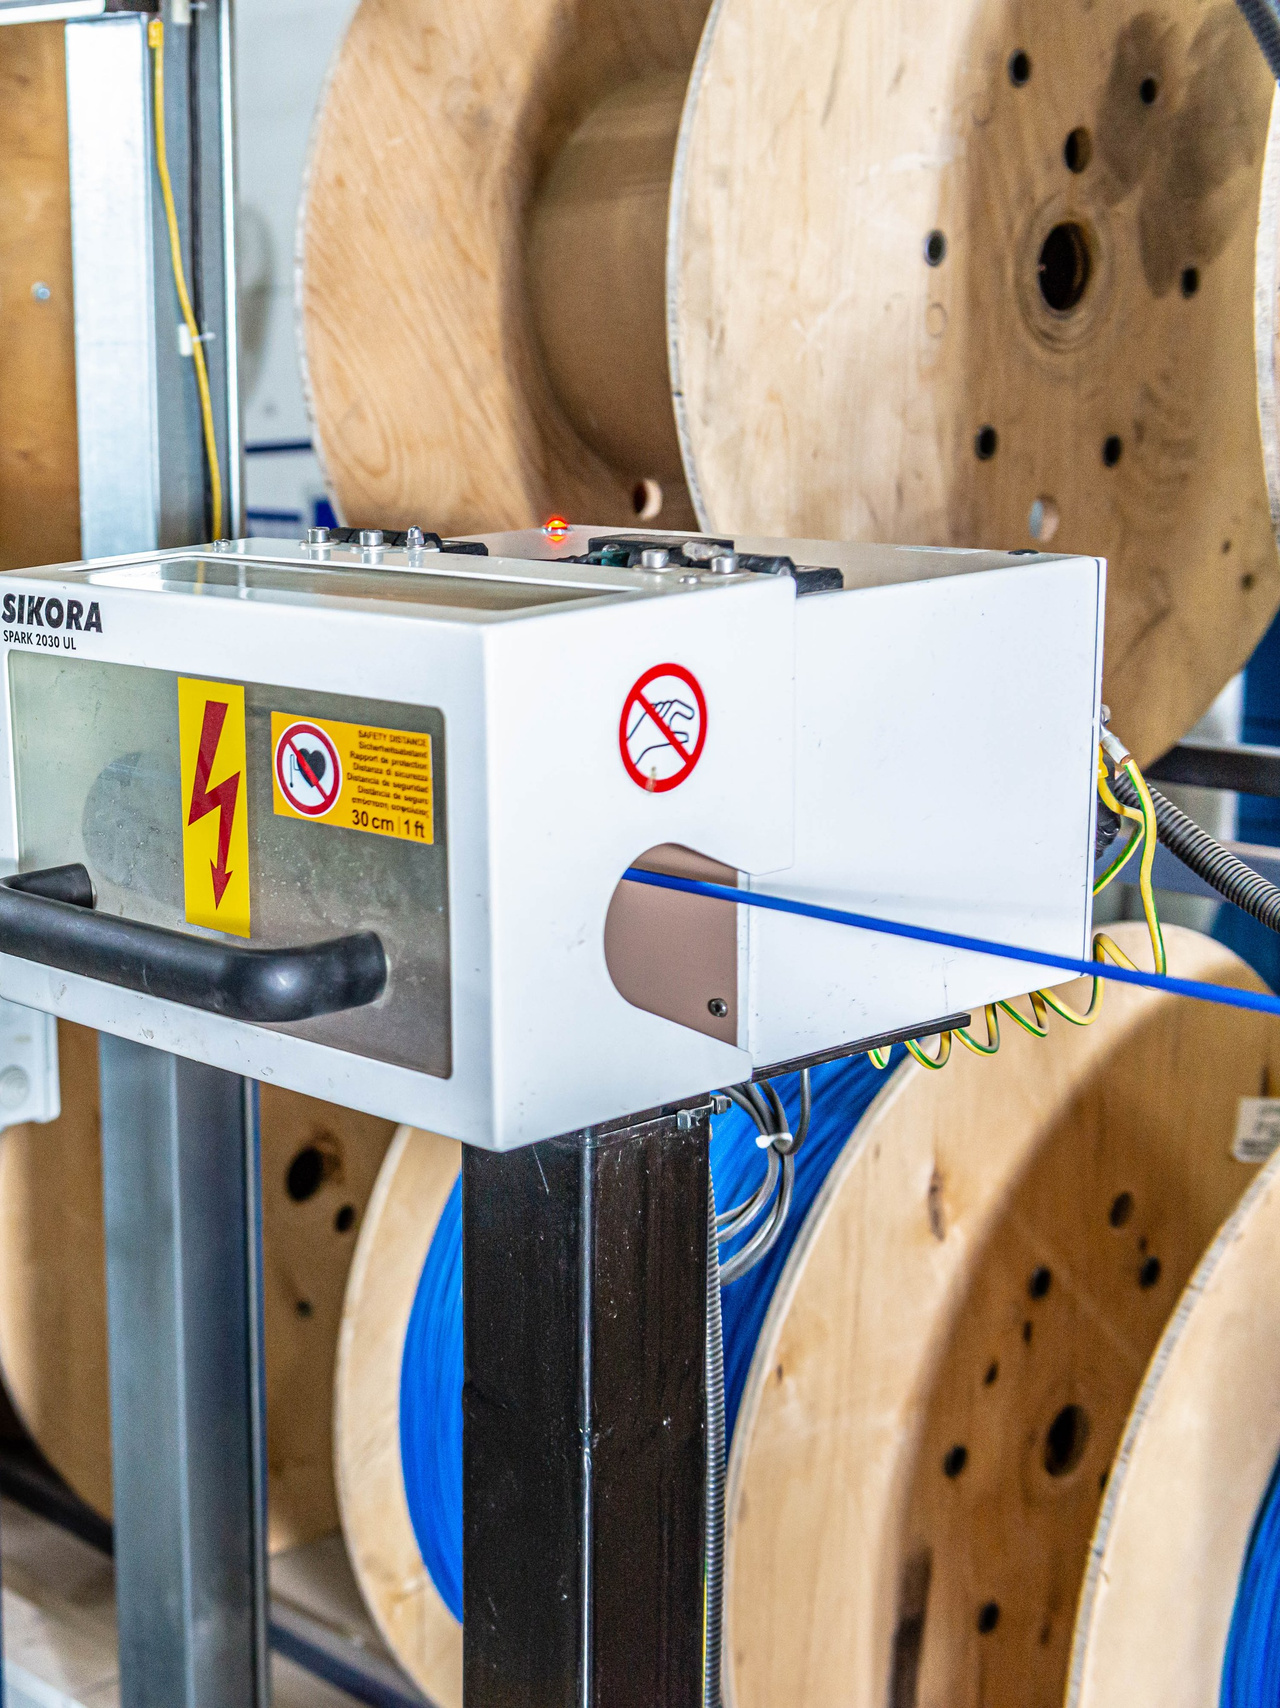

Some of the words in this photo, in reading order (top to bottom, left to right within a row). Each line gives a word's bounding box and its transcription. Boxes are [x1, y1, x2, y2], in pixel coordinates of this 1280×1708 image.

[1, 593, 103, 633] SIKORA
[3, 630, 33, 645] SPARK
[35, 633, 60, 648] 2030
[63, 637, 77, 650] UL
[358, 730, 387, 741] SAFETY
[389, 734, 427, 747] DISTANCE
[349, 750, 378, 762] Rapport
[351, 809, 369, 827] 30
[371, 817, 395, 832] cm
[404, 819, 410, 835] 1
[414, 820, 425, 838] ft
